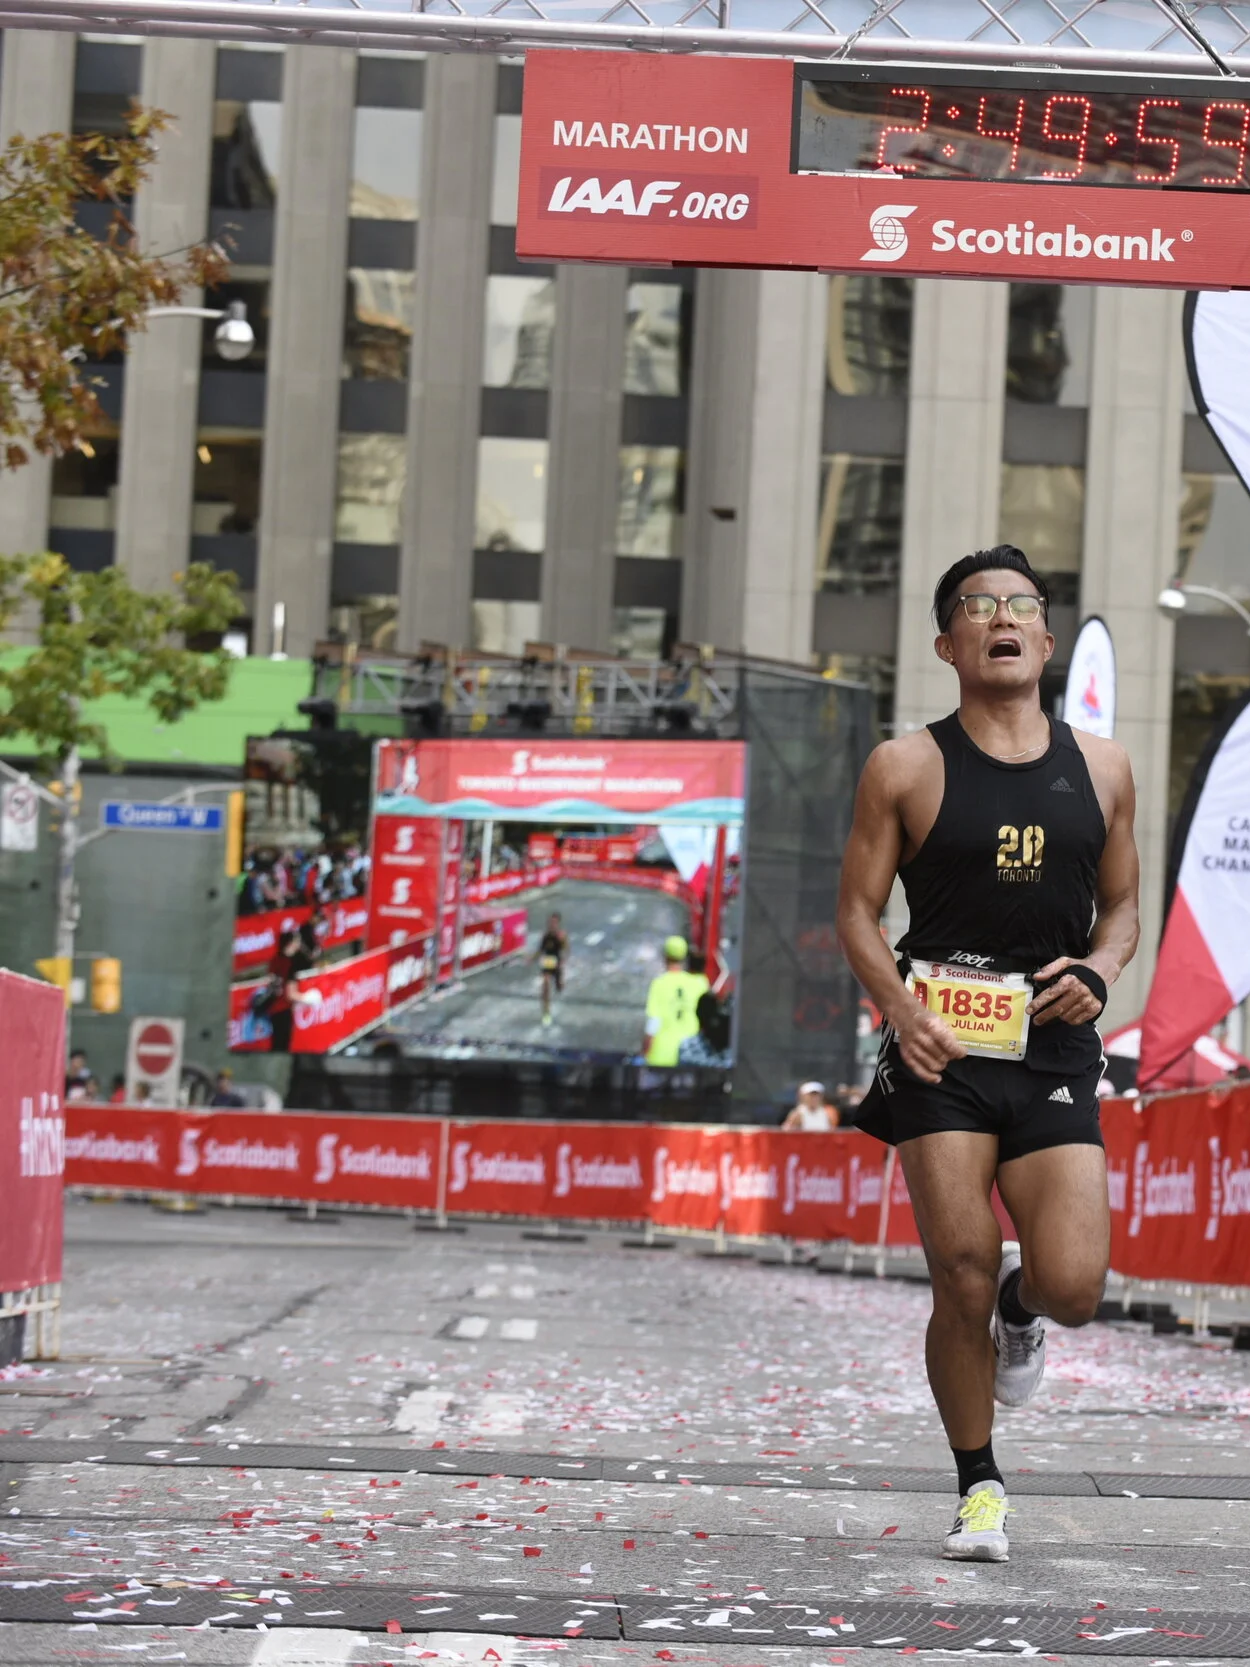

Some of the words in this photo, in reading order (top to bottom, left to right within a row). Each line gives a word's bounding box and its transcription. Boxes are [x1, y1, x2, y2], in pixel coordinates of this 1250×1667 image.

[553, 120, 748, 154] MARATHON
[547, 176, 750, 221] IAAF.ORG
[118, 804, 175, 825] Queen
[997, 869, 1042, 882] TORONTO
[945, 968, 1004, 983] Scotiabank
[938, 988, 1013, 1021] 1835
[951, 1019, 995, 1033] JULIAN
[204, 1138, 300, 1171] Scotiabank
[339, 1143, 431, 1181] Scotiabank
